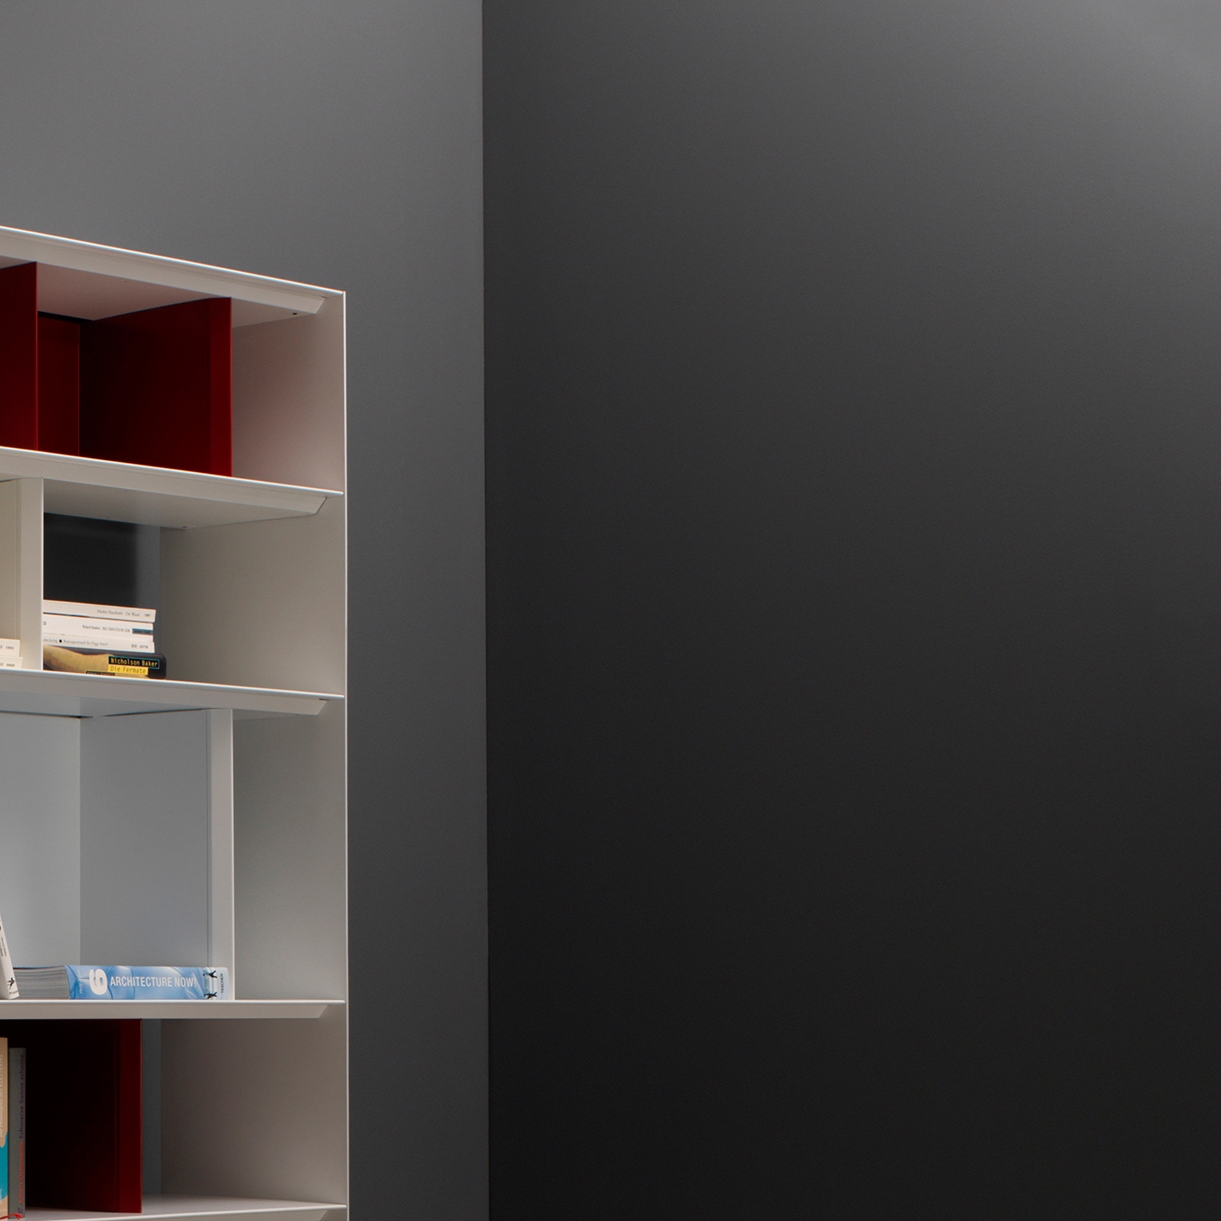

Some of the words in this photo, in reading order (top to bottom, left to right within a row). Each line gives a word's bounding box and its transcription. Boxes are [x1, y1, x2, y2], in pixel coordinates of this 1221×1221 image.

[110, 656, 140, 666] Nicholson
[141, 659, 158, 667] Baker
[89, 968, 108, 995] 6
[110, 976, 173, 987] ARCHITECTURE
[175, 976, 197, 988] NOW!
